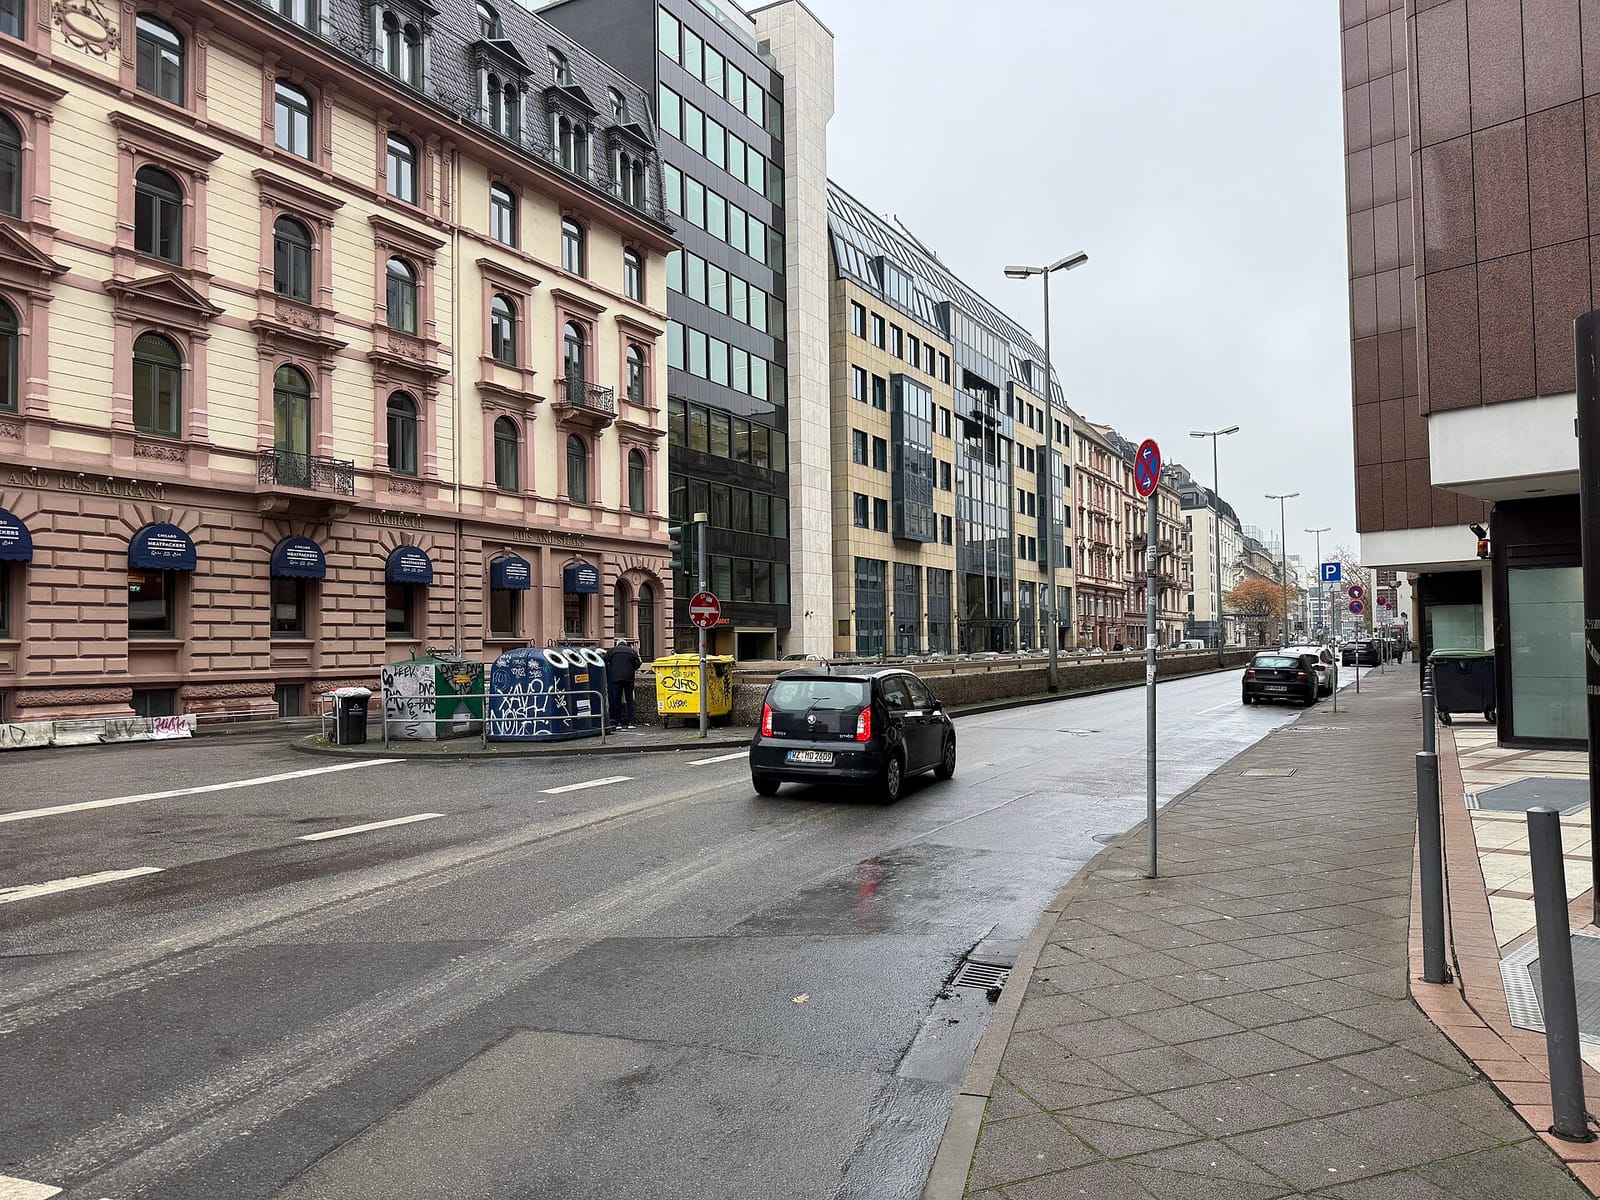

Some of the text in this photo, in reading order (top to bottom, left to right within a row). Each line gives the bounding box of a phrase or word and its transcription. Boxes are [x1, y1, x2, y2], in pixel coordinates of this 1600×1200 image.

[7, 471, 168, 500] AND RESTAURANT
[368, 512, 425, 529] BARBECUE
[147, 541, 187, 549] MEATPACKERS
[286, 551, 318, 559] MEATPACKERS
[1325, 565, 1337, 580] P
[815, 752, 831, 761] 2609
